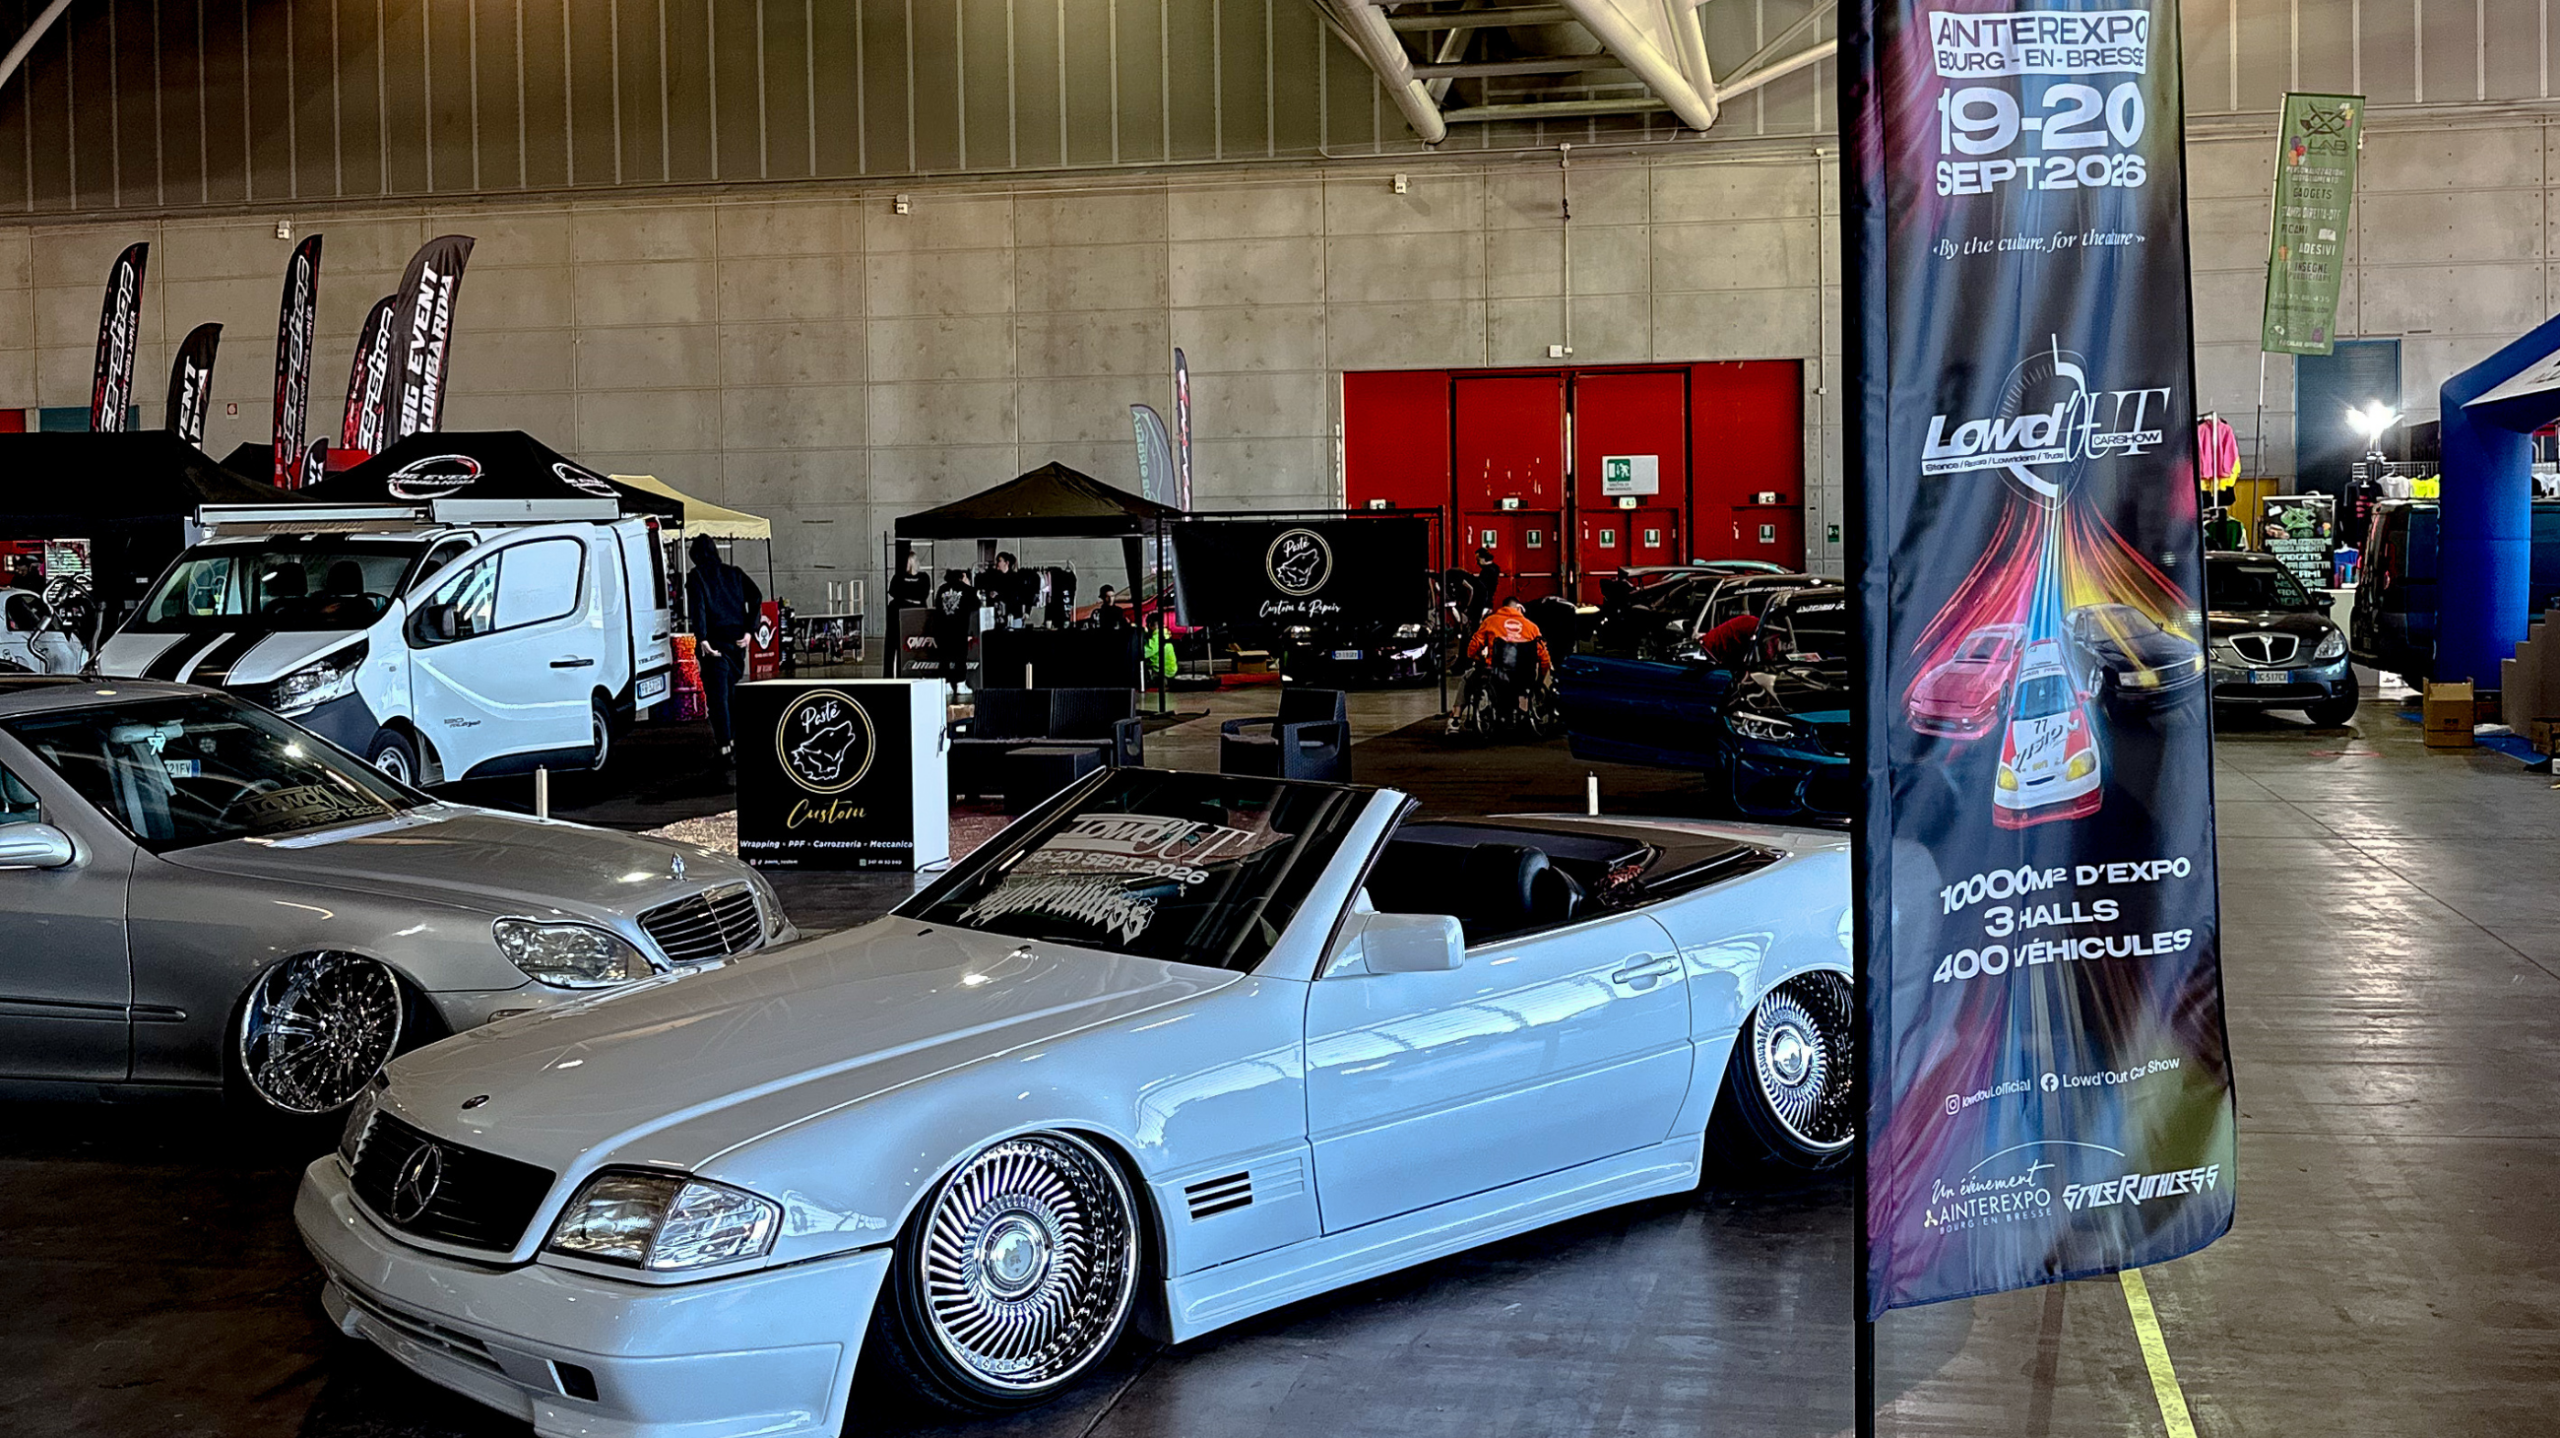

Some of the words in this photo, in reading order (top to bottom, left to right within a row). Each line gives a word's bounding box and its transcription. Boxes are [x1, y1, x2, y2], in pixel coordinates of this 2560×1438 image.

[1937, 81, 2146, 156] 19-20
[2293, 187, 2333, 200] GADGETS
[1963, 236, 1994, 255] the
[2047, 231, 2078, 253] for
[2298, 243, 2337, 256] ADESIVI
[2294, 261, 2328, 273] INSEGNE
[408, 260, 439, 376] EVENT
[178, 355, 197, 440] ENT
[2276, 553, 2322, 562] GADGETS
[786, 798, 867, 829] Custom
[739, 840, 781, 849] Wrapping
[787, 840, 806, 848] PPF
[813, 840, 862, 848] Carrozzeria
[870, 840, 913, 848] Meccanica
[2075, 857, 2191, 886] D'EXPO
[1984, 906, 2015, 938] 3
[2018, 899, 2120, 931] HALLS
[1933, 945, 2010, 984] 400
[2014, 929, 2193, 968] VÉHICULES
[2063, 1071, 2128, 1088] Lowd'Out
[2130, 1067, 2146, 1081] Car
[2147, 1057, 2181, 1074] Show
[1939, 1188, 2052, 1224] AINTEREXPO
